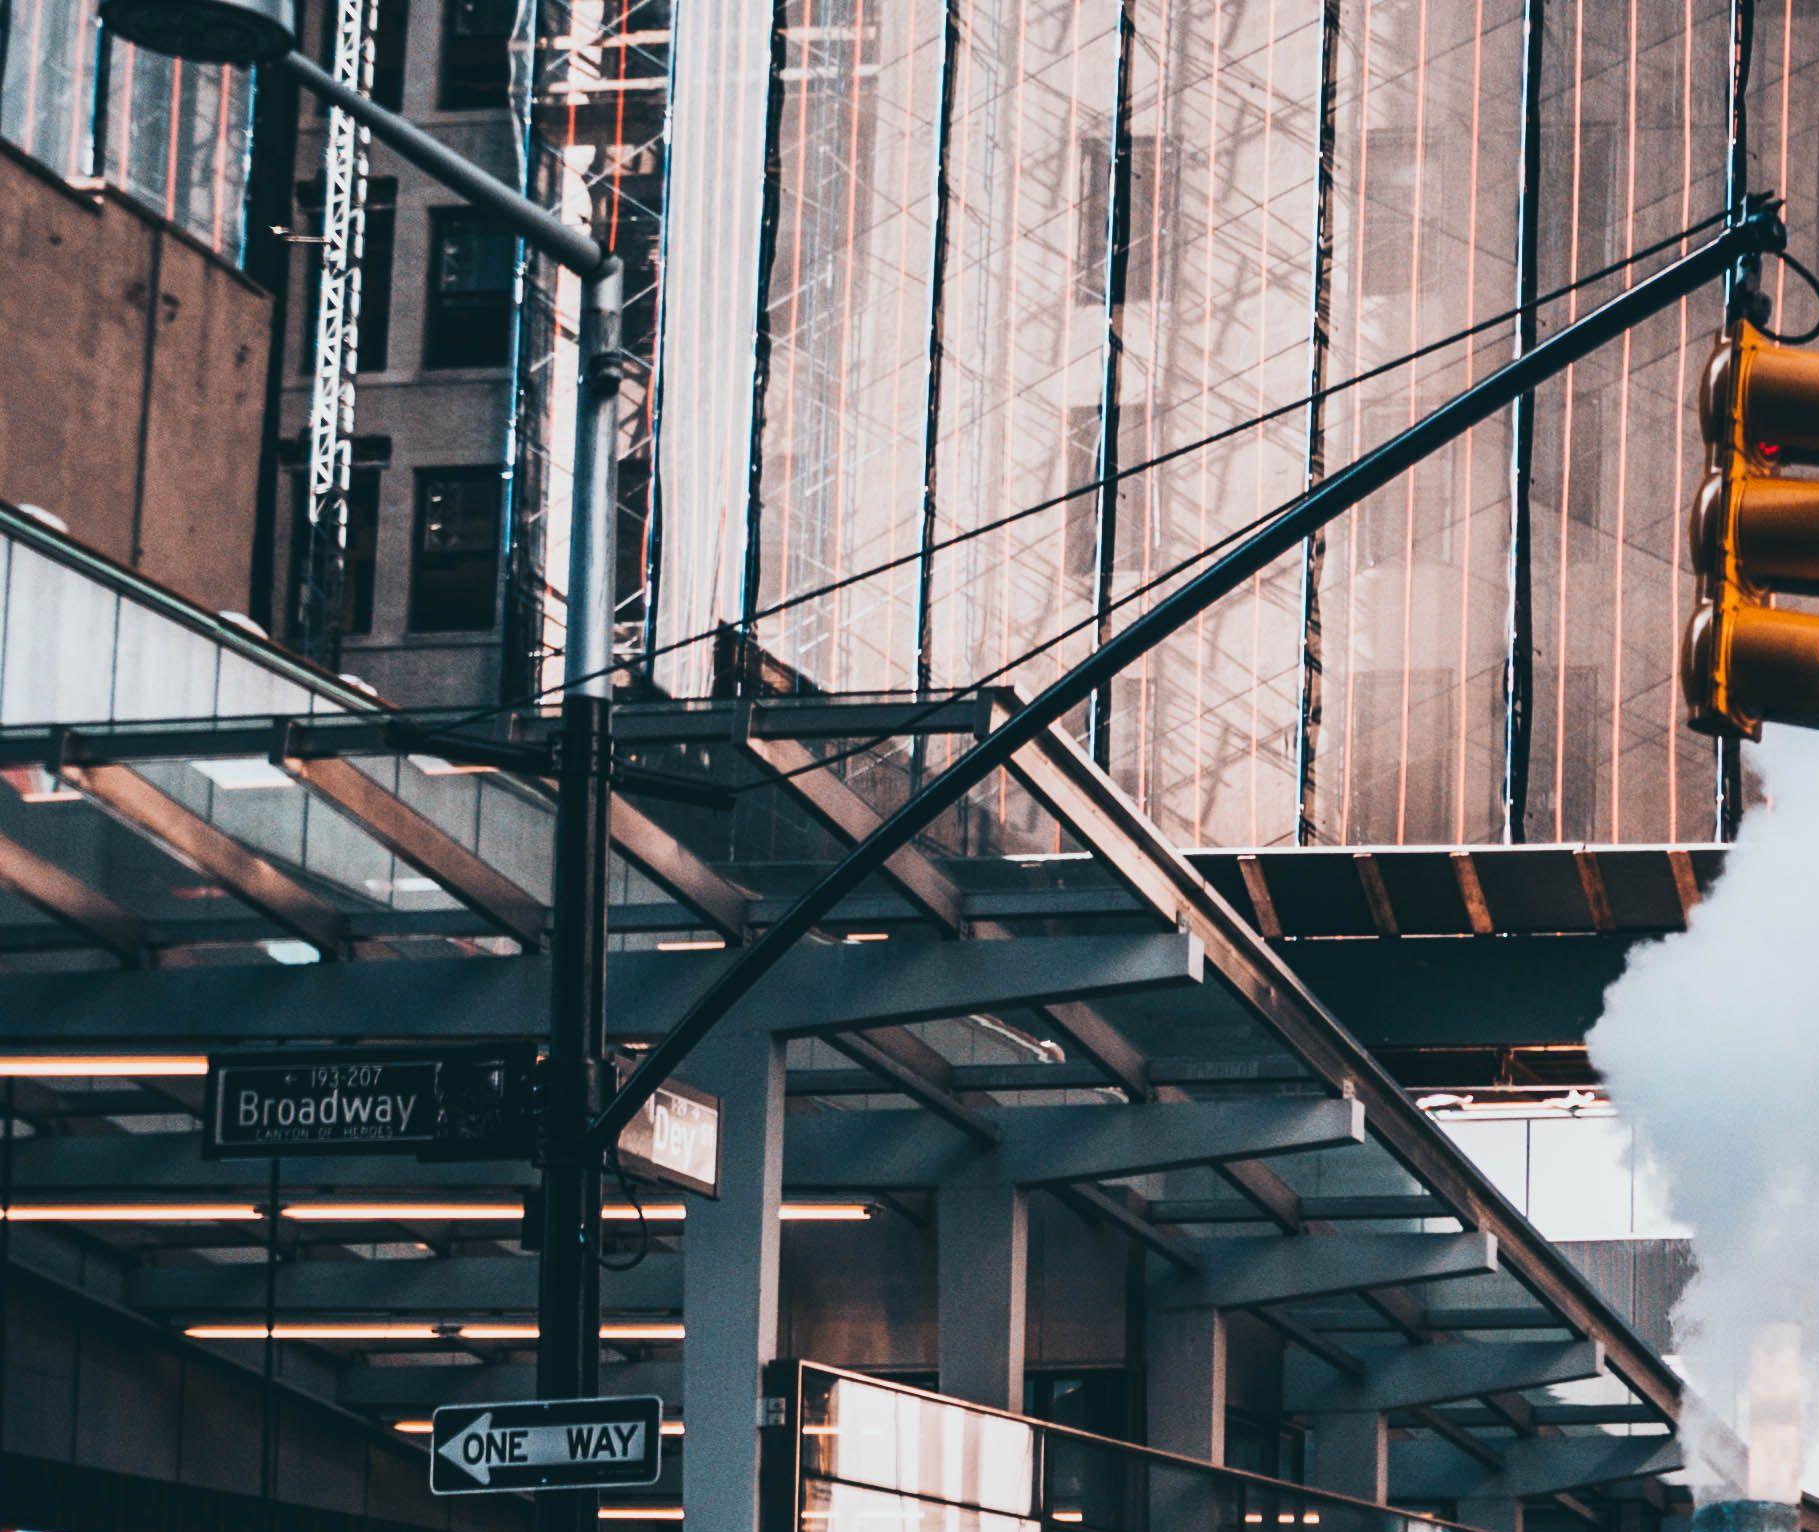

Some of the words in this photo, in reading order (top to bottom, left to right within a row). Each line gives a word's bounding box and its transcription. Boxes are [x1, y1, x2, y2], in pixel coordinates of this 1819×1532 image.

[310, 1066, 384, 1089] 193-207
[238, 1088, 417, 1133] Broadway
[653, 1104, 697, 1170] Dey
[462, 1431, 529, 1466] ONE
[566, 1423, 639, 1461] WAY
